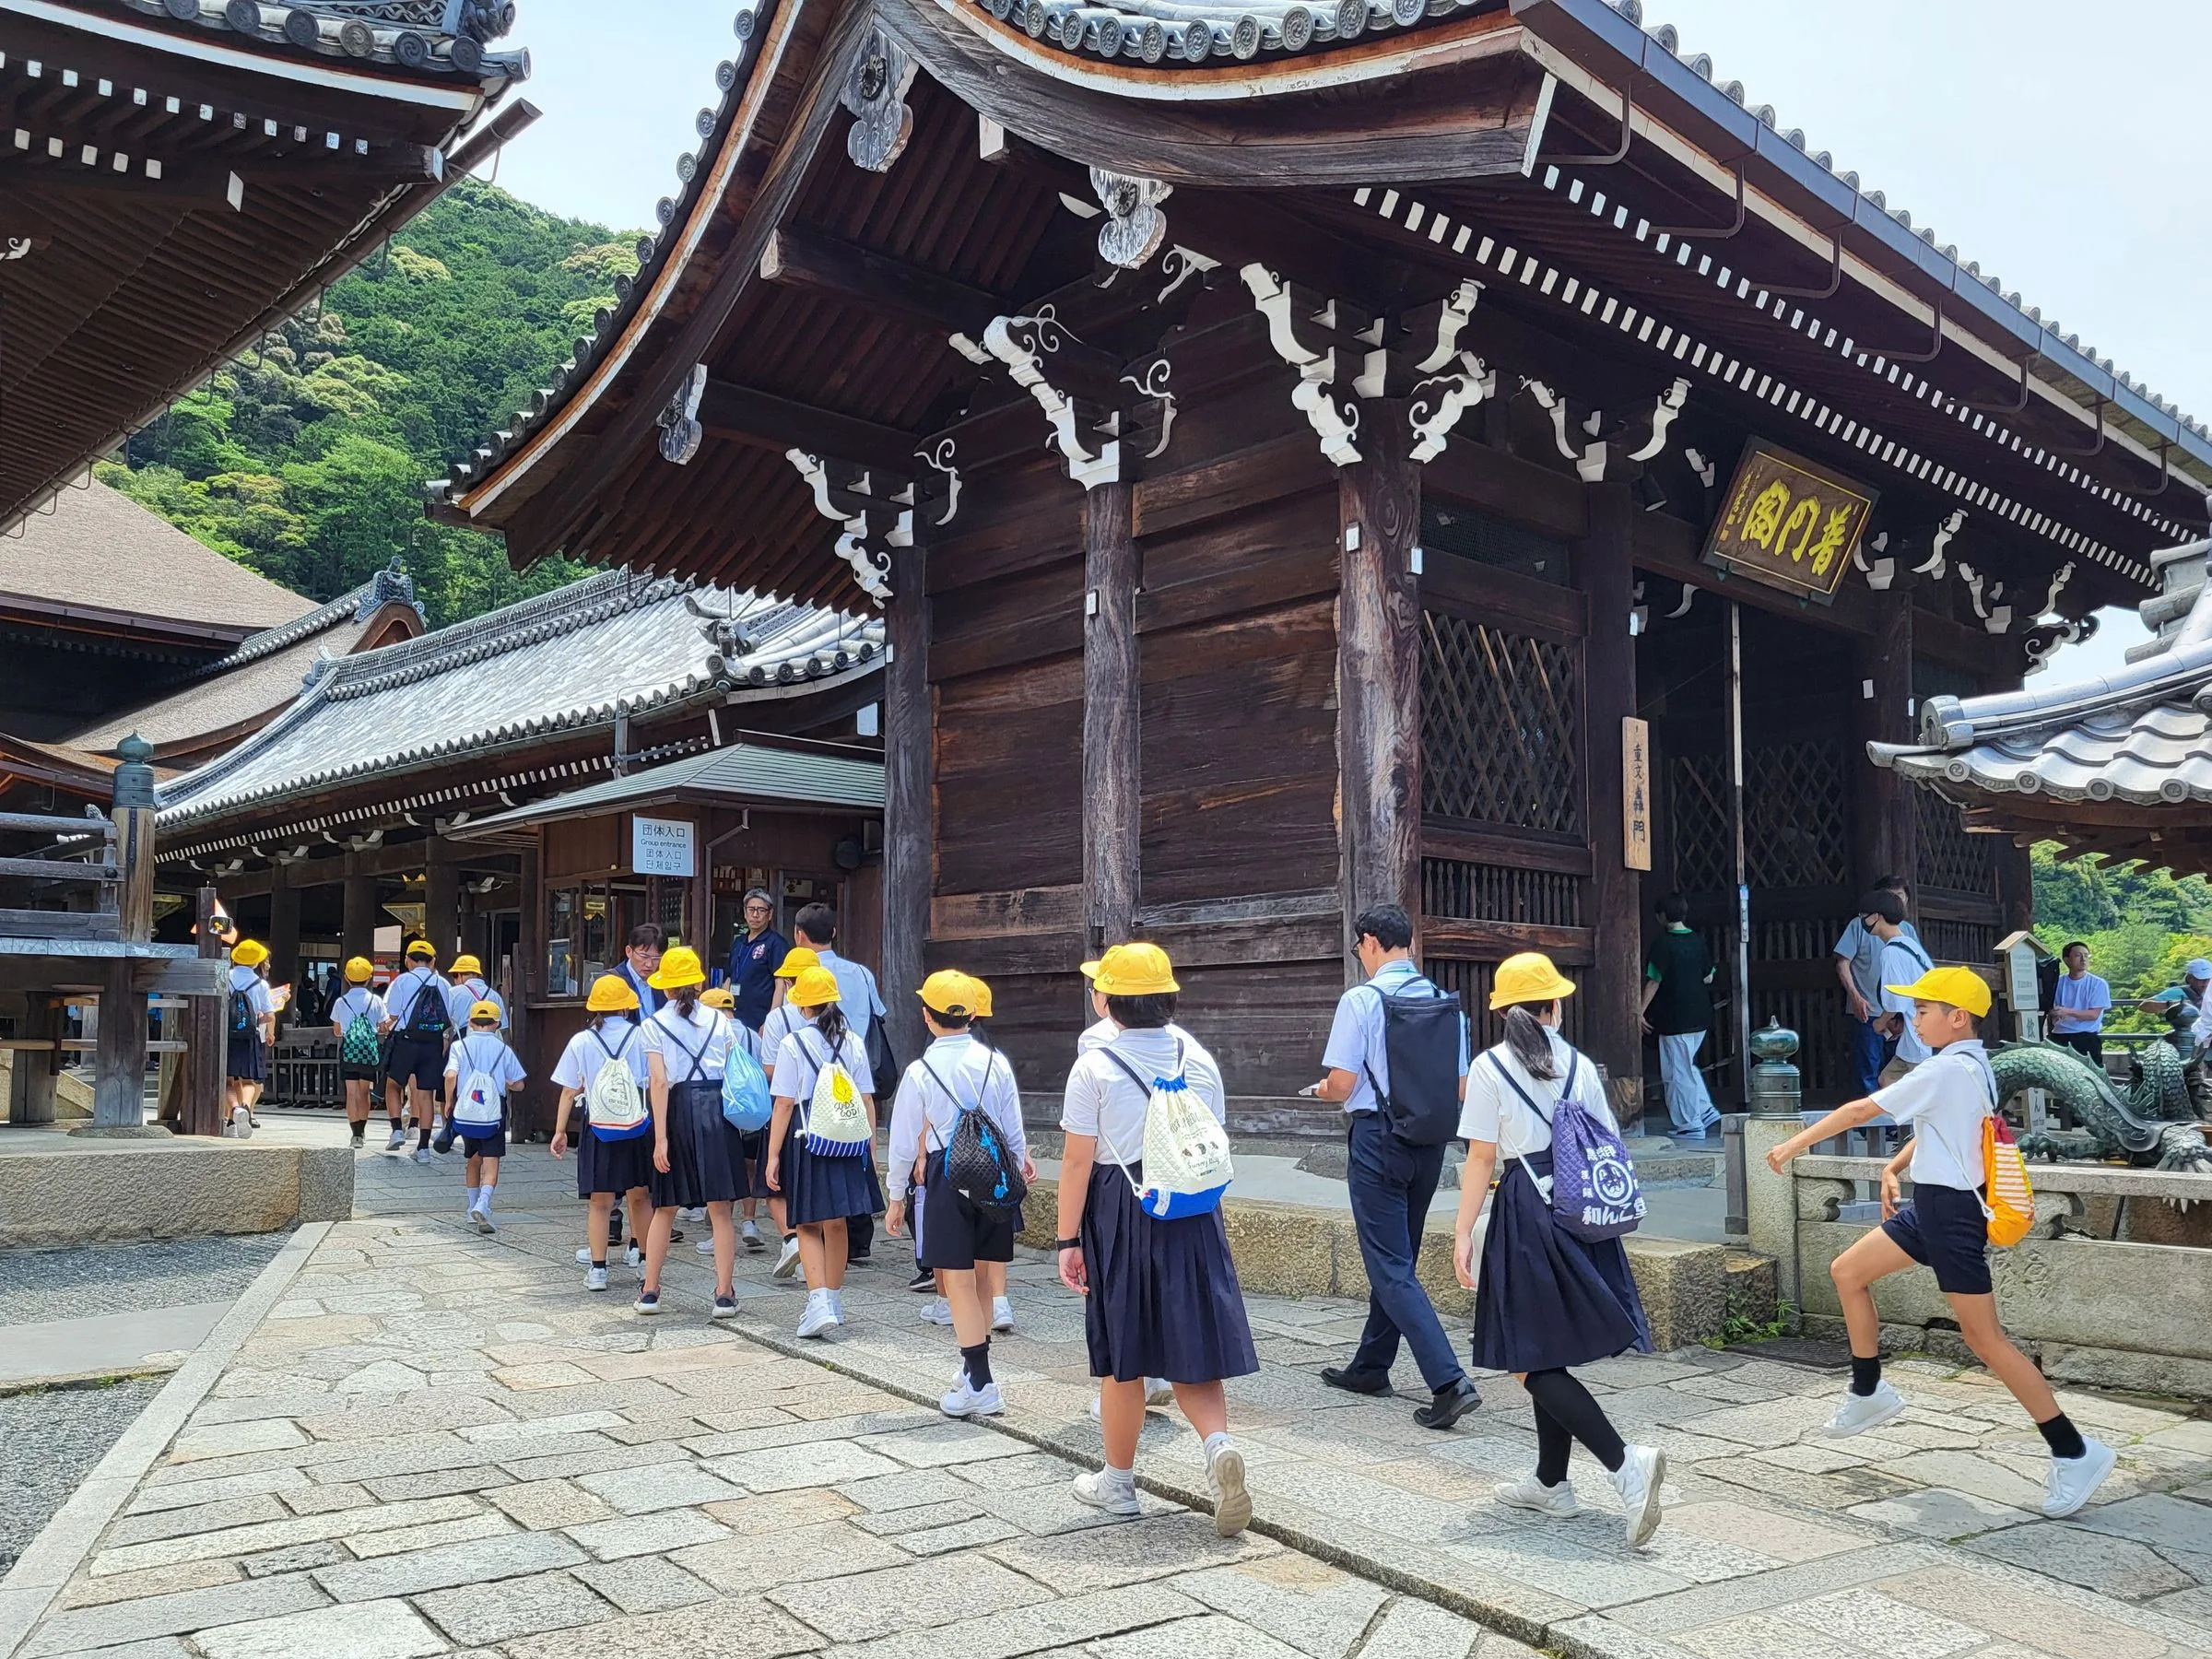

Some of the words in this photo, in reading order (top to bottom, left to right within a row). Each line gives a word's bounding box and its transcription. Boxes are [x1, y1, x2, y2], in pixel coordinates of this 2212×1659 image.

[642, 824, 685, 837] 団体入口
[641, 838, 659, 847] Group
[660, 841, 687, 849] entrance
[646, 860, 681, 870] 단체입구
[1582, 1197, 1648, 1226] 和んこ堂
